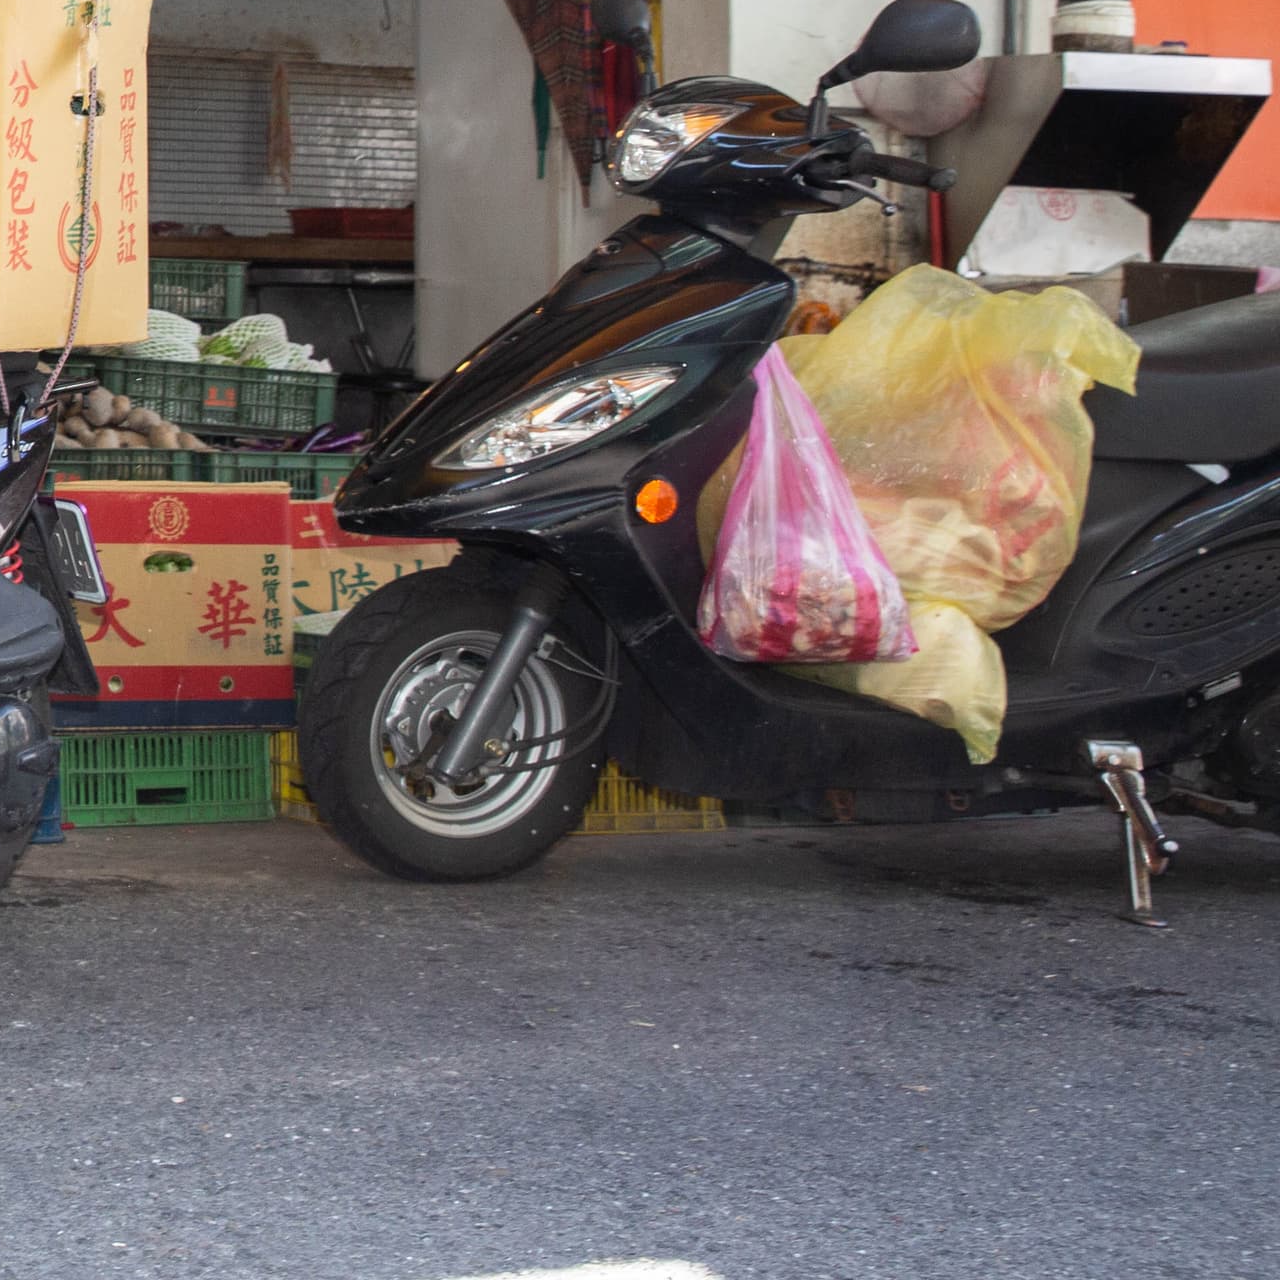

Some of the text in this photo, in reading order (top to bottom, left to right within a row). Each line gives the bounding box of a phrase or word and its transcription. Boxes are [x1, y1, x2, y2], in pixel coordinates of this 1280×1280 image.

[6, 58, 40, 273] 分級包裝
[116, 68, 139, 266] 品質保証
[86, 580, 257, 650] 大華
[260, 553, 285, 657] 品質保証
